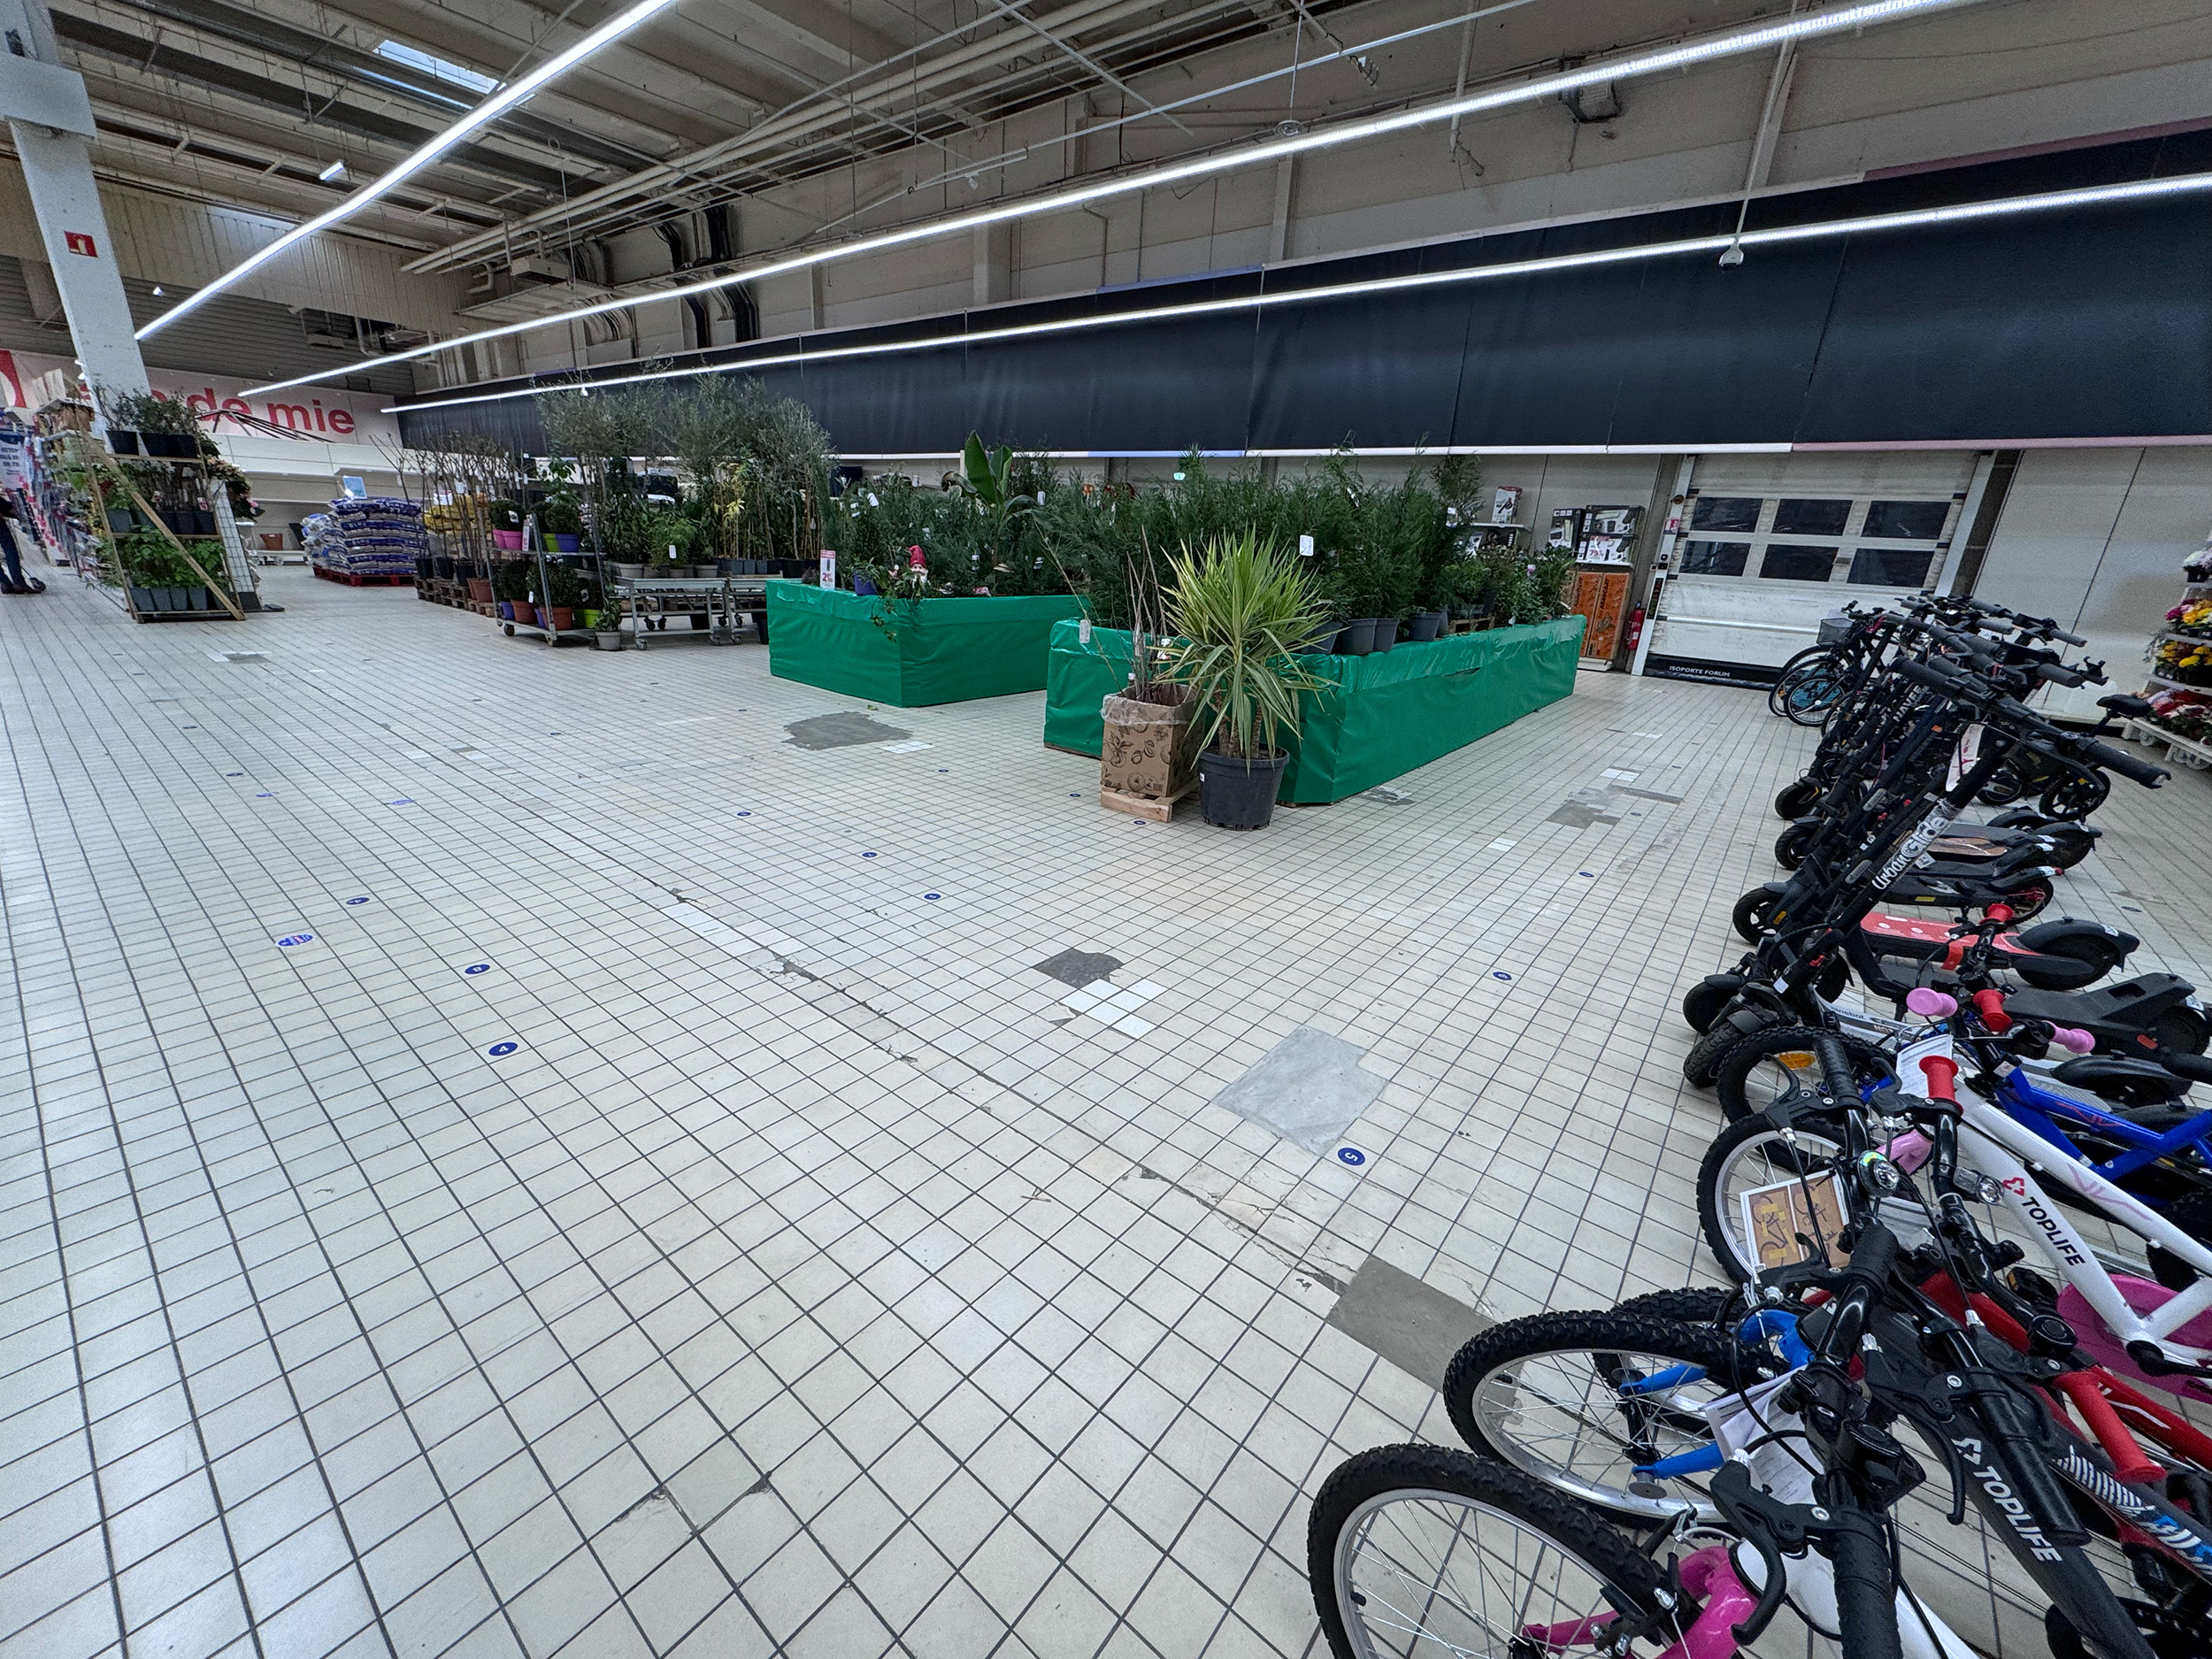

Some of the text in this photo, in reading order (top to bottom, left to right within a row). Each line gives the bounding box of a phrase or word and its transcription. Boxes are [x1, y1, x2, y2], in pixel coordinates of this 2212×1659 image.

[266, 399, 355, 434] mie
[1669, 665, 1703, 674] ISOPORTE
[1871, 816, 1947, 890] UrbanGlide
[1345, 1152, 1358, 1162] 5
[2022, 1196, 2085, 1266] TOPLIFE
[1973, 1465, 2062, 1562] TOPLIFE
